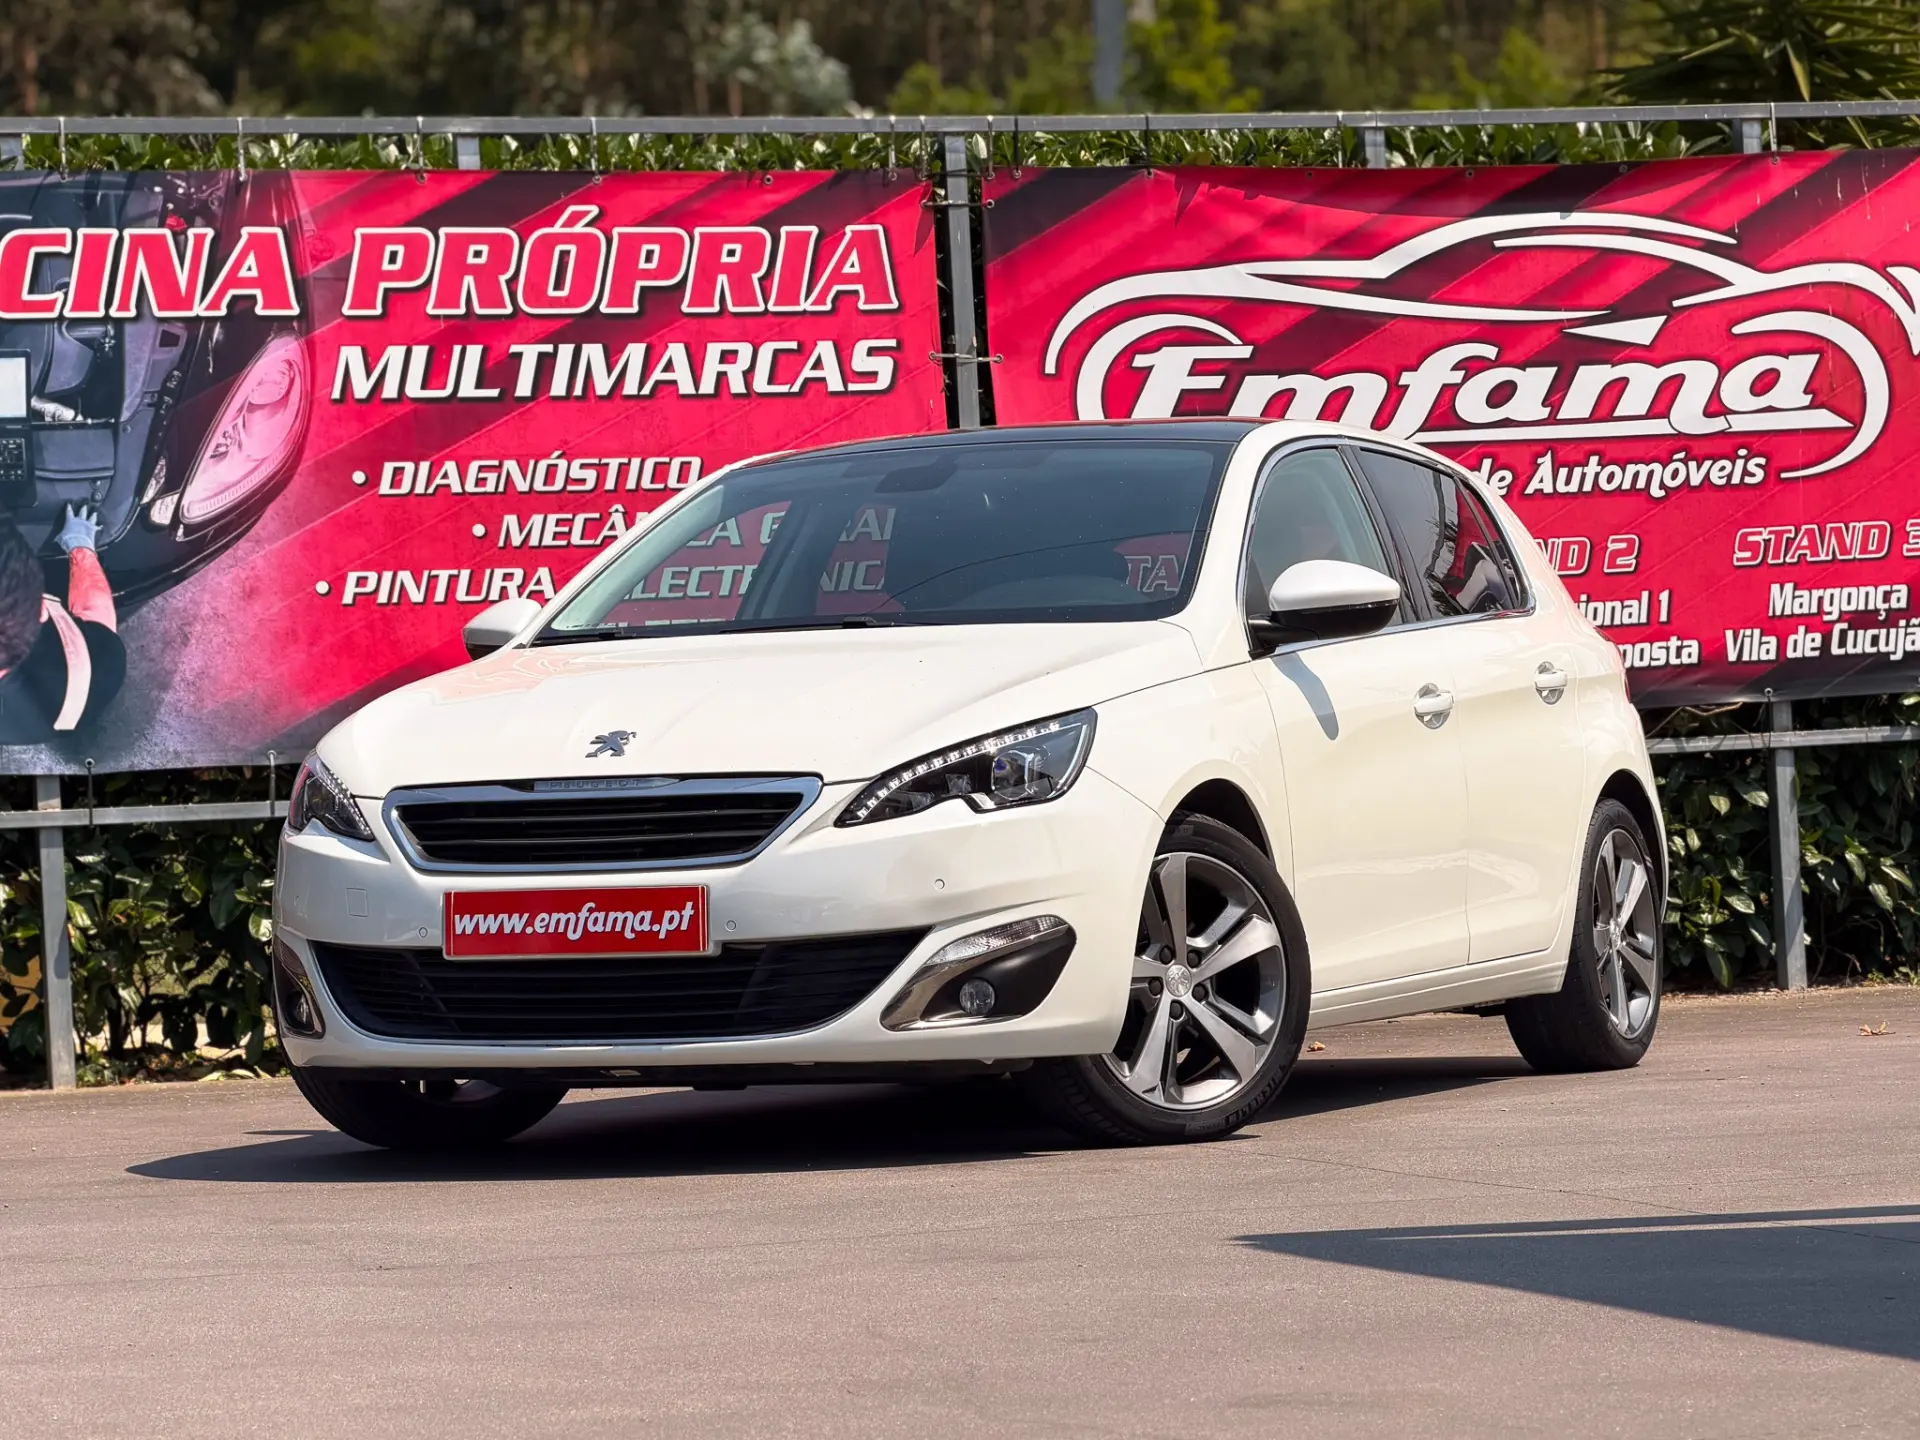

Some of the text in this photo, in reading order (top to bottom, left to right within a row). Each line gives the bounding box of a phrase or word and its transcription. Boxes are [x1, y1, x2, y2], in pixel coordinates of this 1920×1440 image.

[0, 205, 899, 319] CINA PRÓPRIA
[331, 339, 897, 399] MULTIMARCAS
[379, 451, 700, 495] DIAGNÓSTICO
[1525, 449, 1766, 498] Automóveis
[1603, 534, 1639, 573] 2
[1733, 520, 1891, 566] STAND
[342, 567, 556, 606] PINTURA
[1768, 582, 1908, 621] Margonça
[1575, 589, 1670, 626] ional 1
[1725, 628, 1777, 662] Vila
[1786, 625, 1822, 659] de
[454, 901, 695, 941] www.emfama.pt
